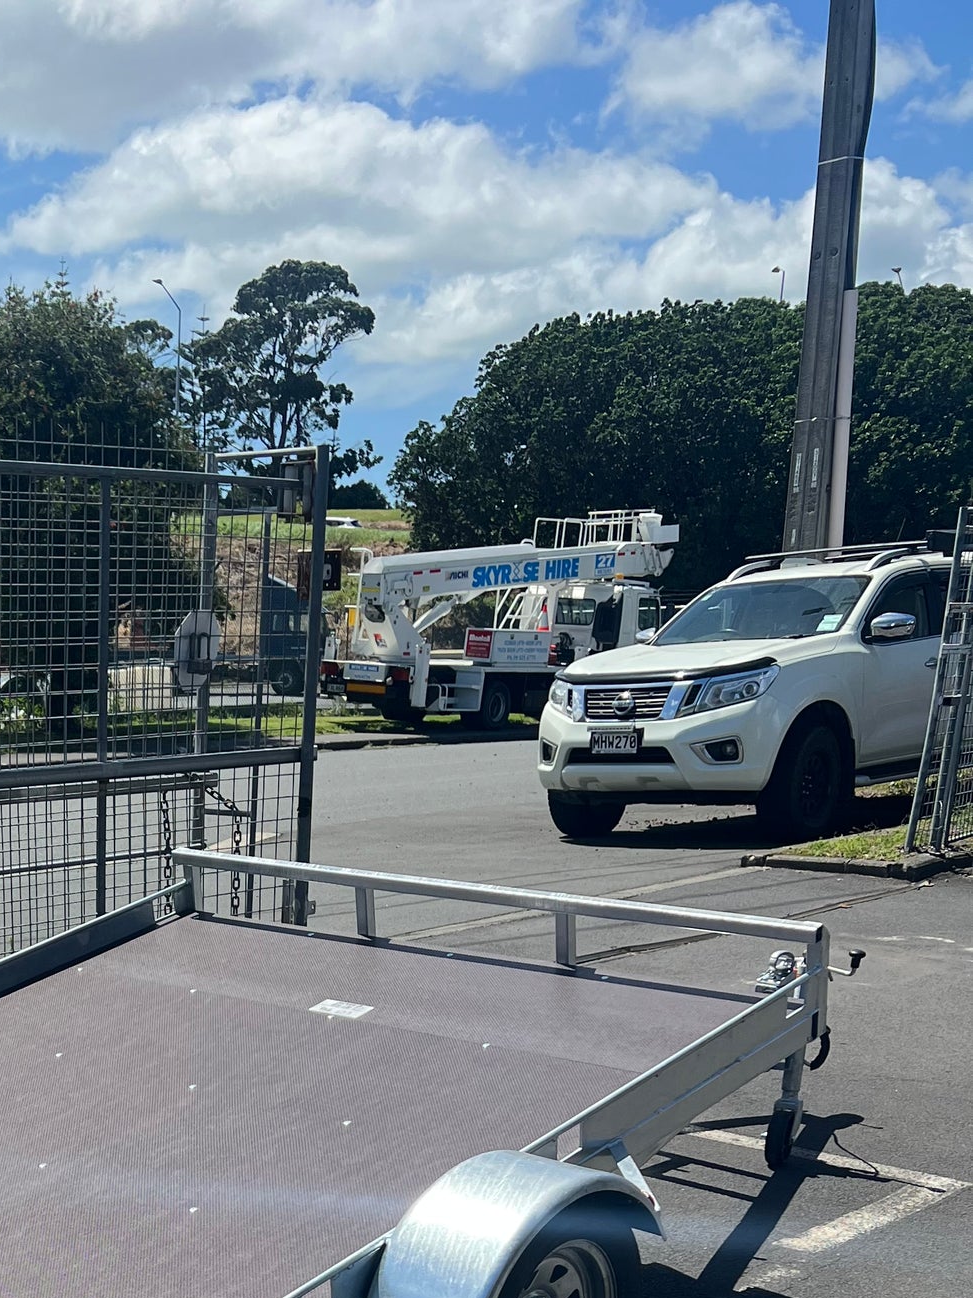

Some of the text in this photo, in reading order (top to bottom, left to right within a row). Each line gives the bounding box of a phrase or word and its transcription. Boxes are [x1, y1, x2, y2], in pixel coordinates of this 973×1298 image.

[597, 554, 614, 567] 27
[545, 558, 579, 580] HIRE
[593, 735, 636, 749] MHW270
